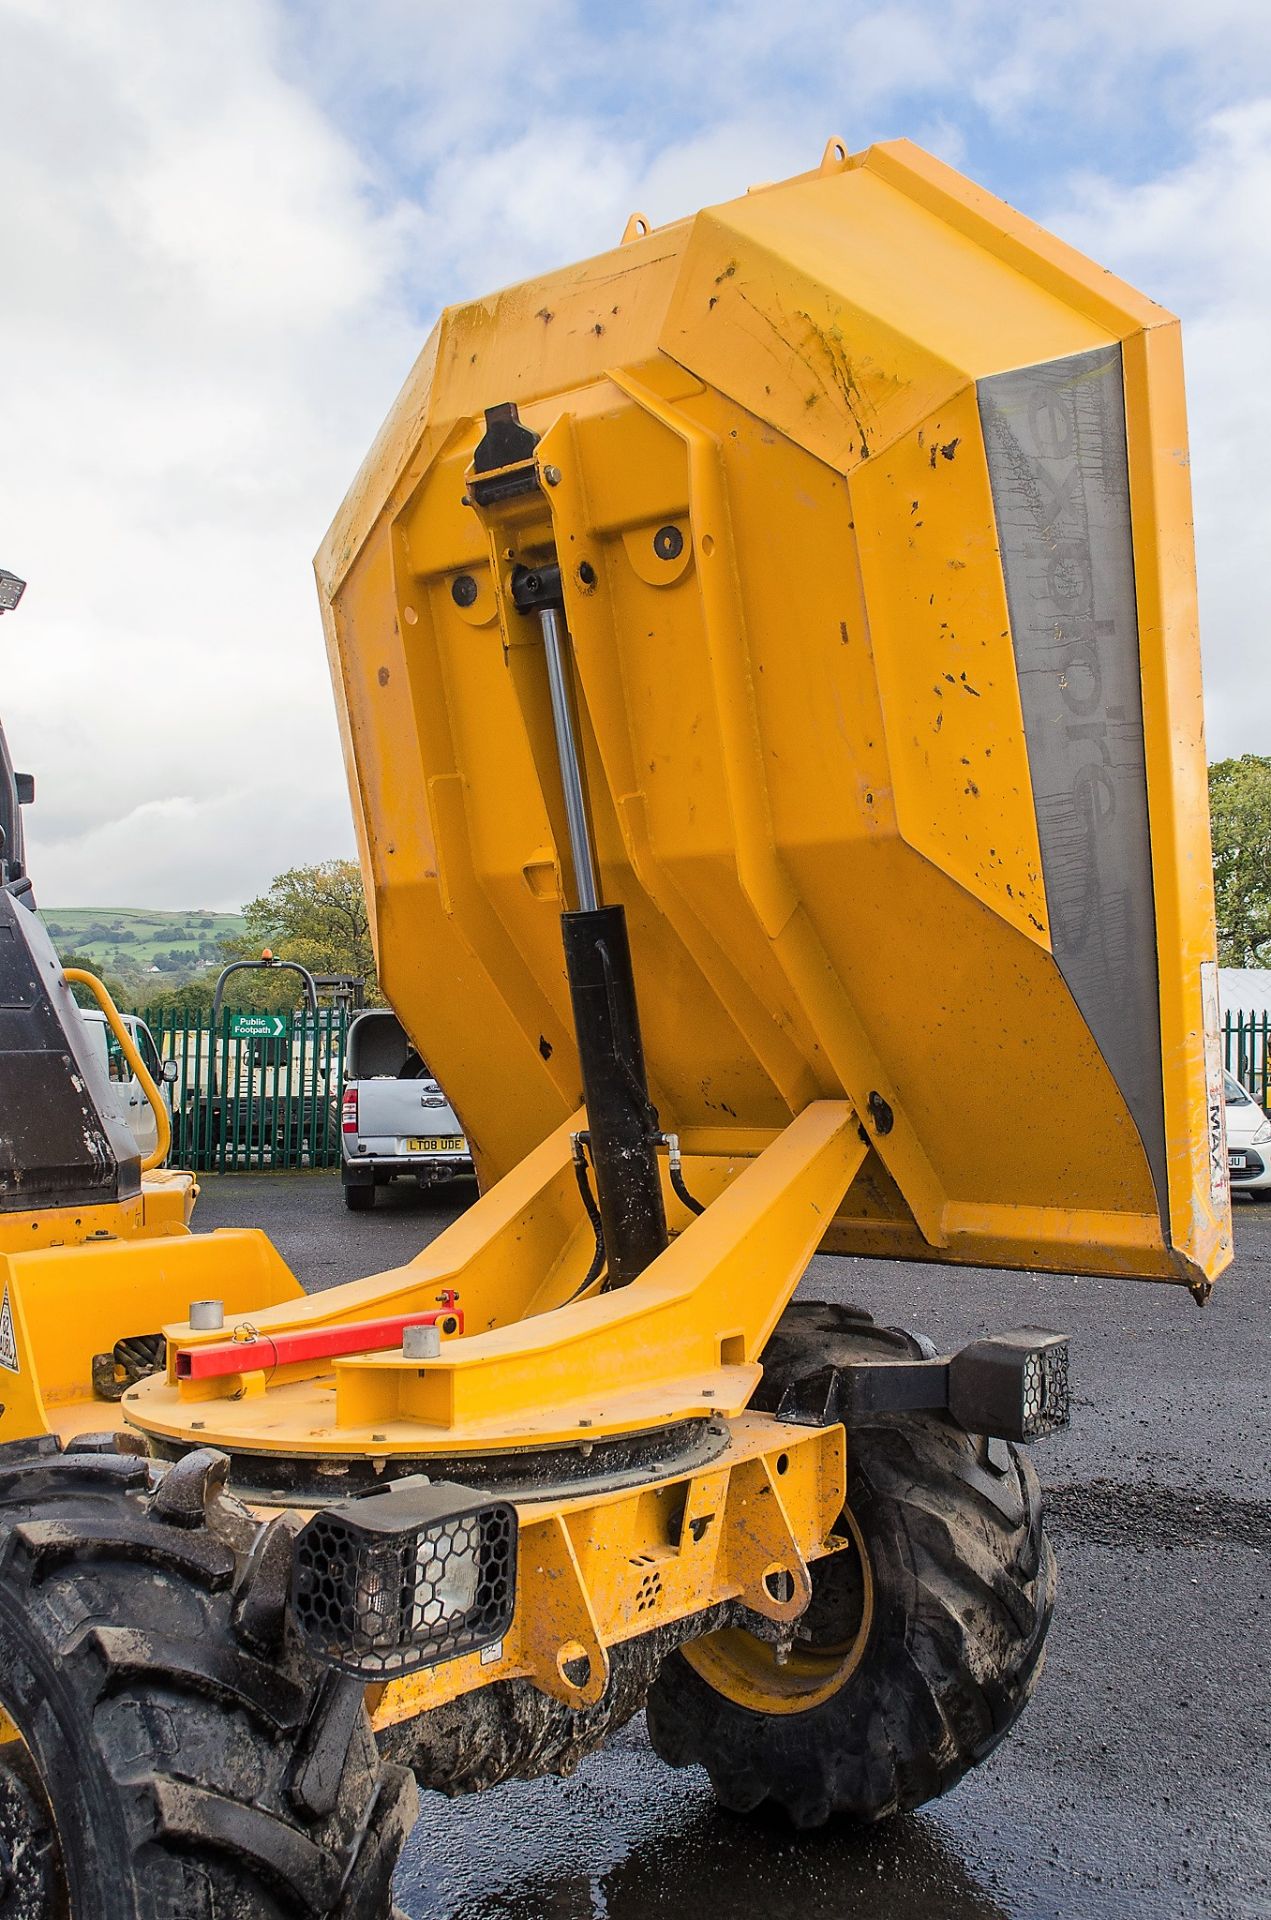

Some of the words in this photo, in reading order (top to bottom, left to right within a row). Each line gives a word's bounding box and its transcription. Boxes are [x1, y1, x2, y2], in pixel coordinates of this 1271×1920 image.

[240, 1017, 266, 1026] Public
[234, 1025, 271, 1035] Footpath
[409, 1140, 437, 1150] LT08
[440, 1139, 462, 1150] UDE
